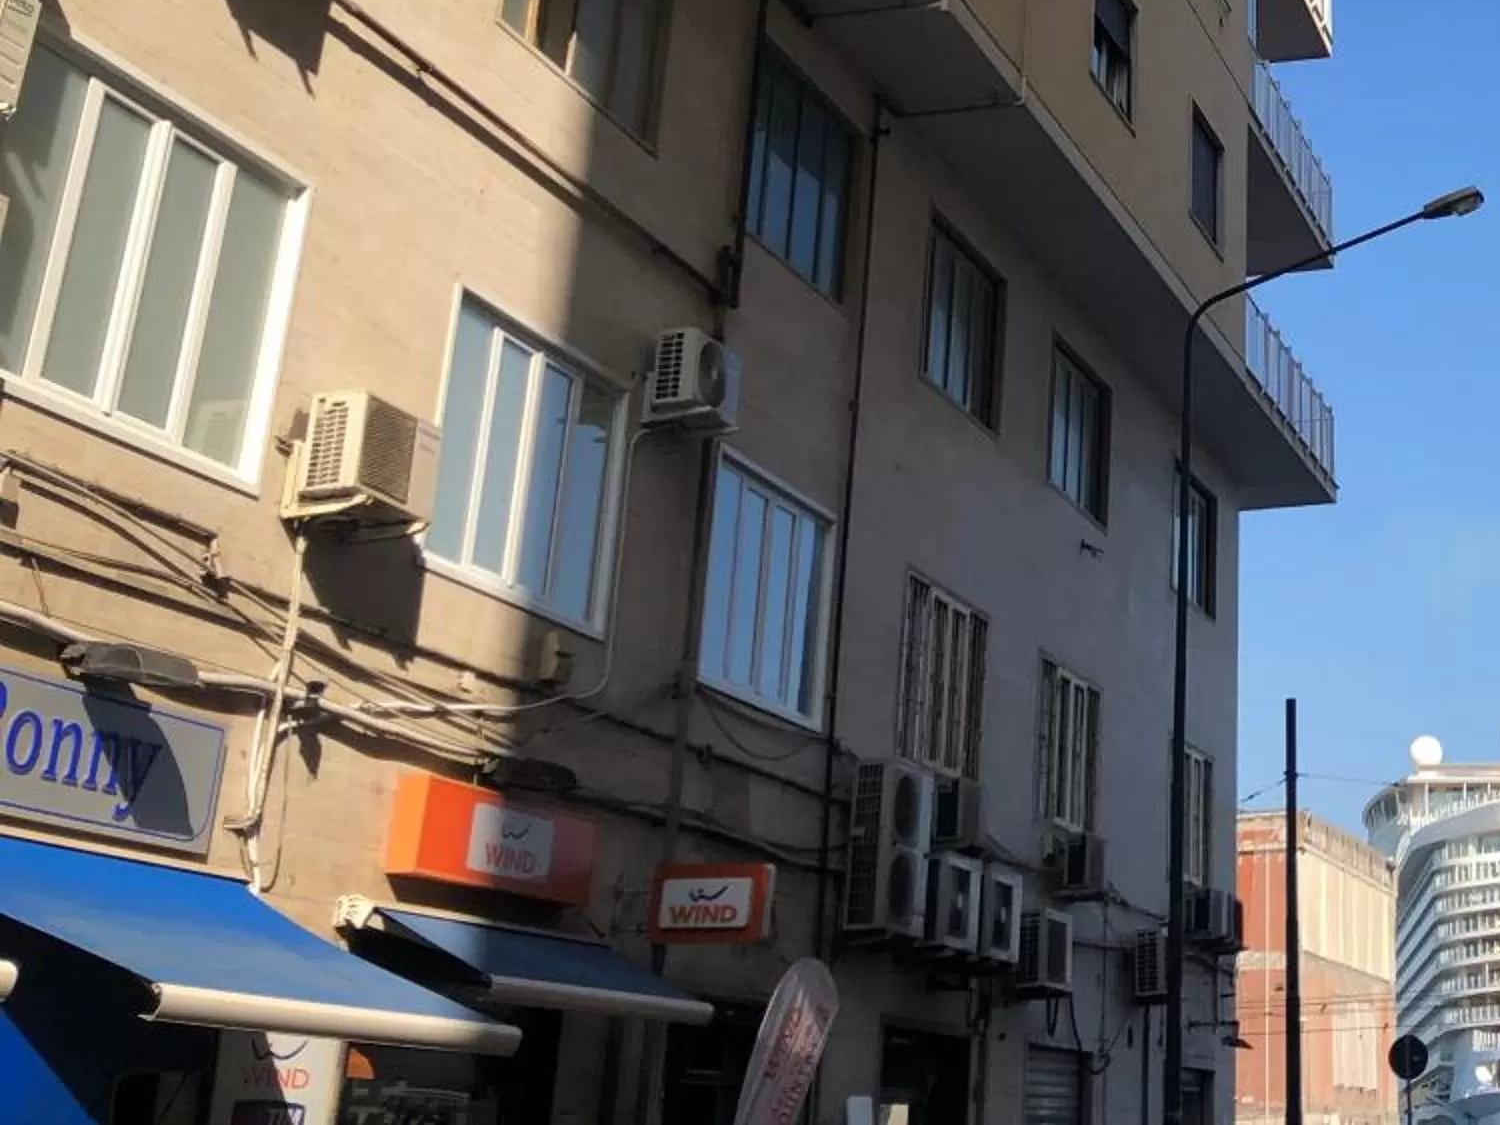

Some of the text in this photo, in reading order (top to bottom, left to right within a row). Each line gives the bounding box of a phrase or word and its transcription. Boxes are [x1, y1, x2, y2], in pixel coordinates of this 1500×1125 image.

[485, 842, 536, 874] WIND
[669, 904, 737, 925] WIND
[240, 1065, 309, 1089] WIND
